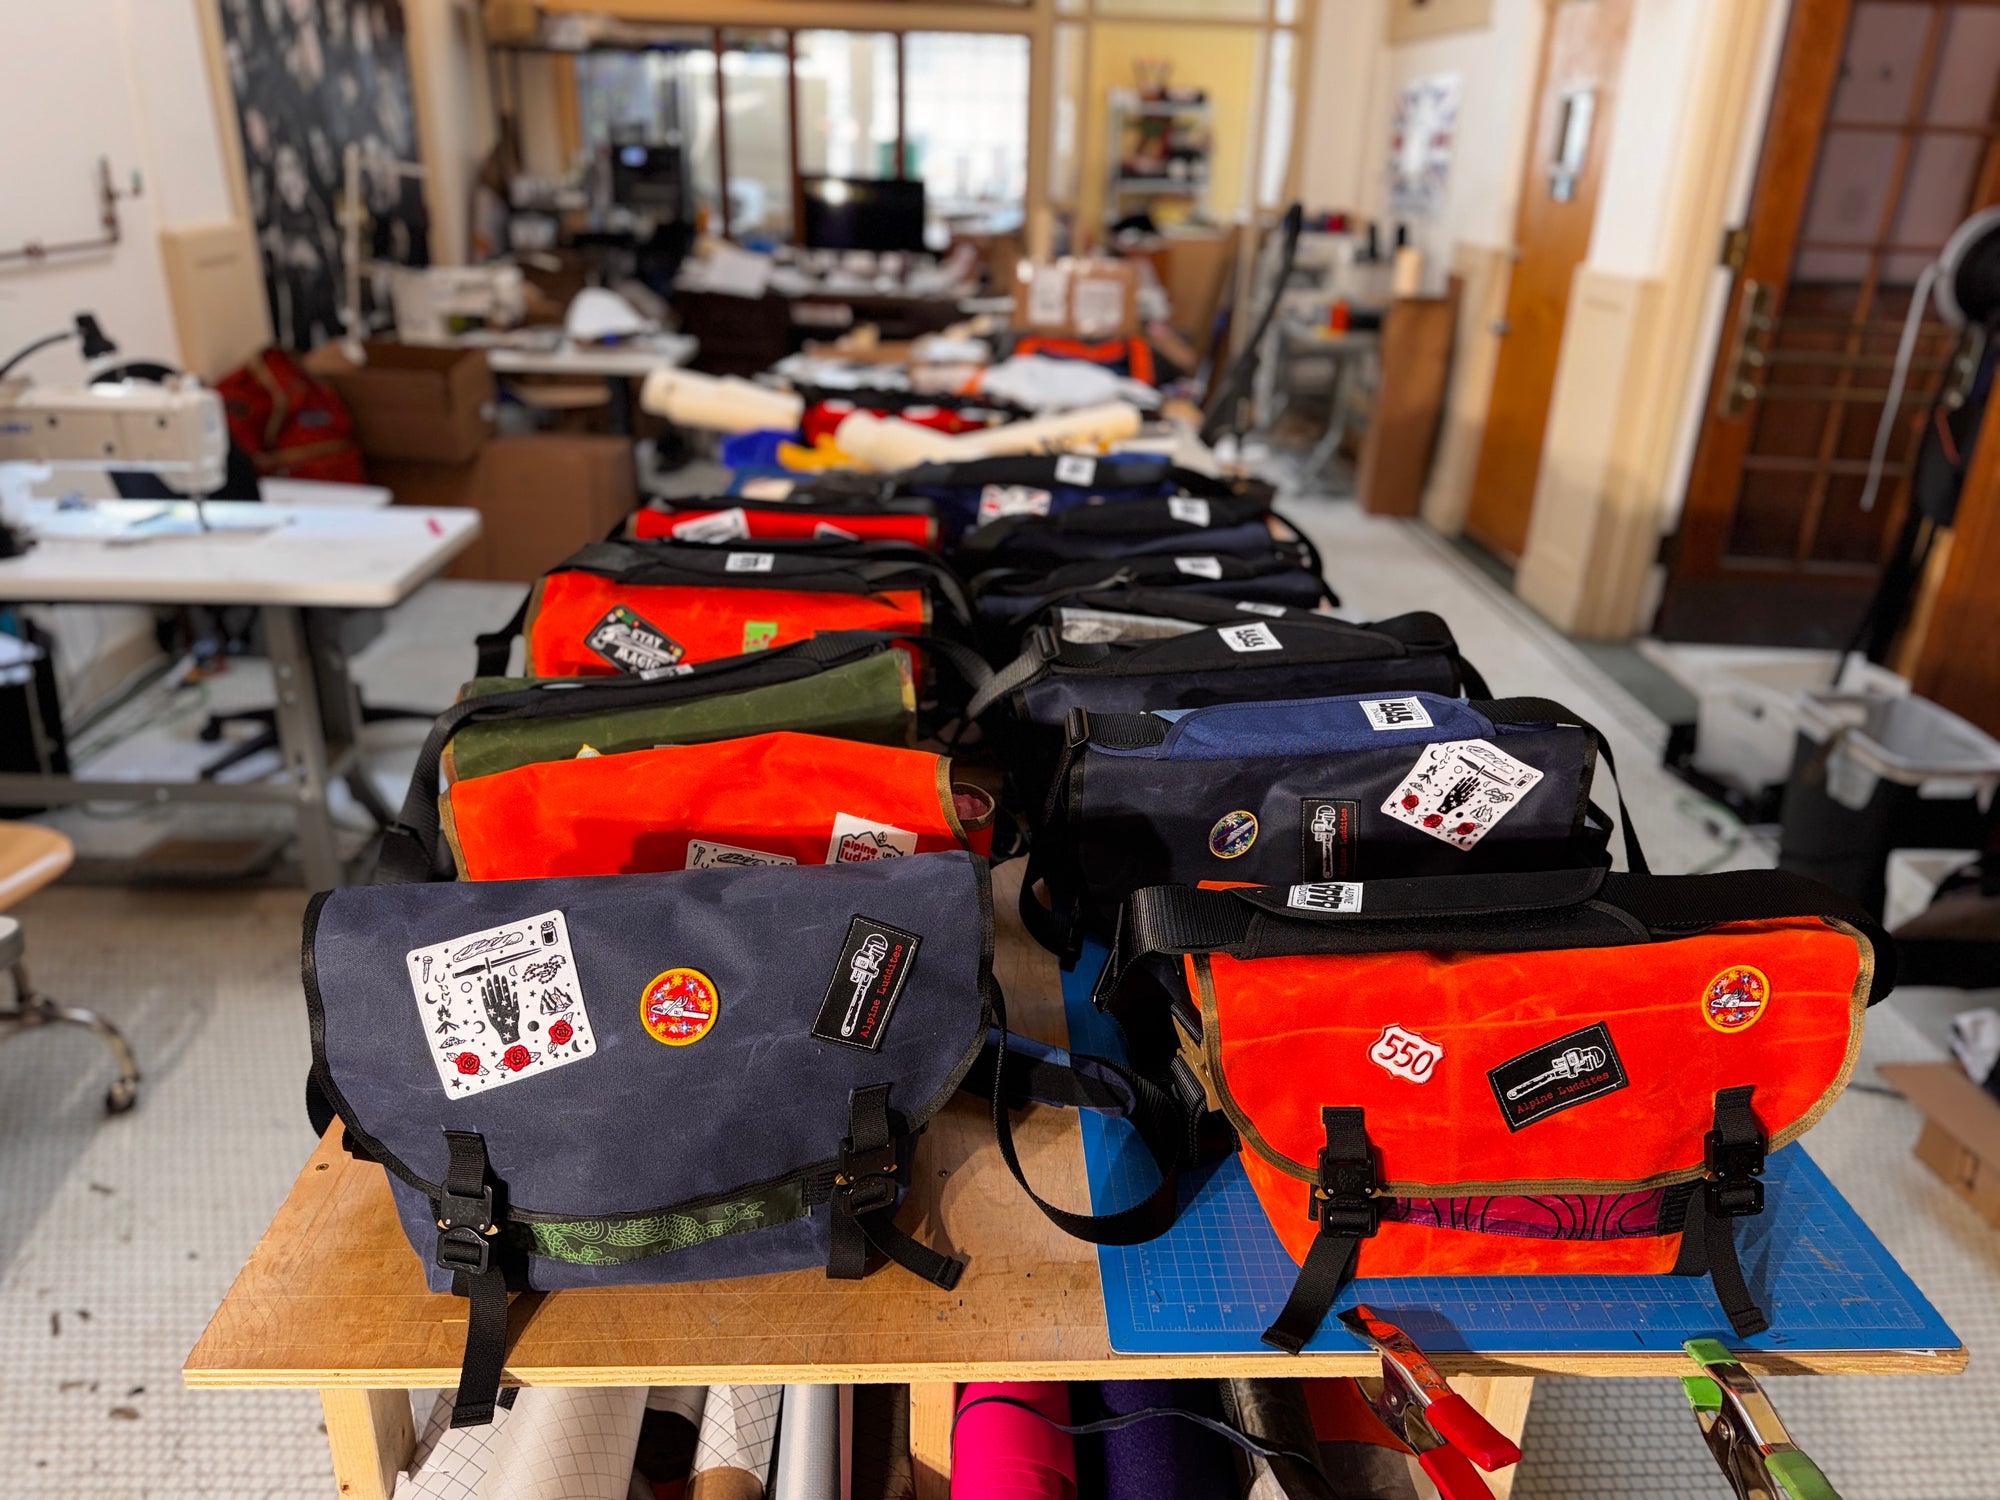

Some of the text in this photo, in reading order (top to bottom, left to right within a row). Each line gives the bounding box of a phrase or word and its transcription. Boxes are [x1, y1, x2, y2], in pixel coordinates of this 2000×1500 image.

[631, 628, 664, 650] STAY
[614, 646, 661, 670] MAGIC
[843, 840, 878, 856] alpine
[860, 944, 903, 1038] Alpine Luddites
[1378, 1034, 1433, 1075] 550
[1517, 1071, 1610, 1114] Alpine Luddites
